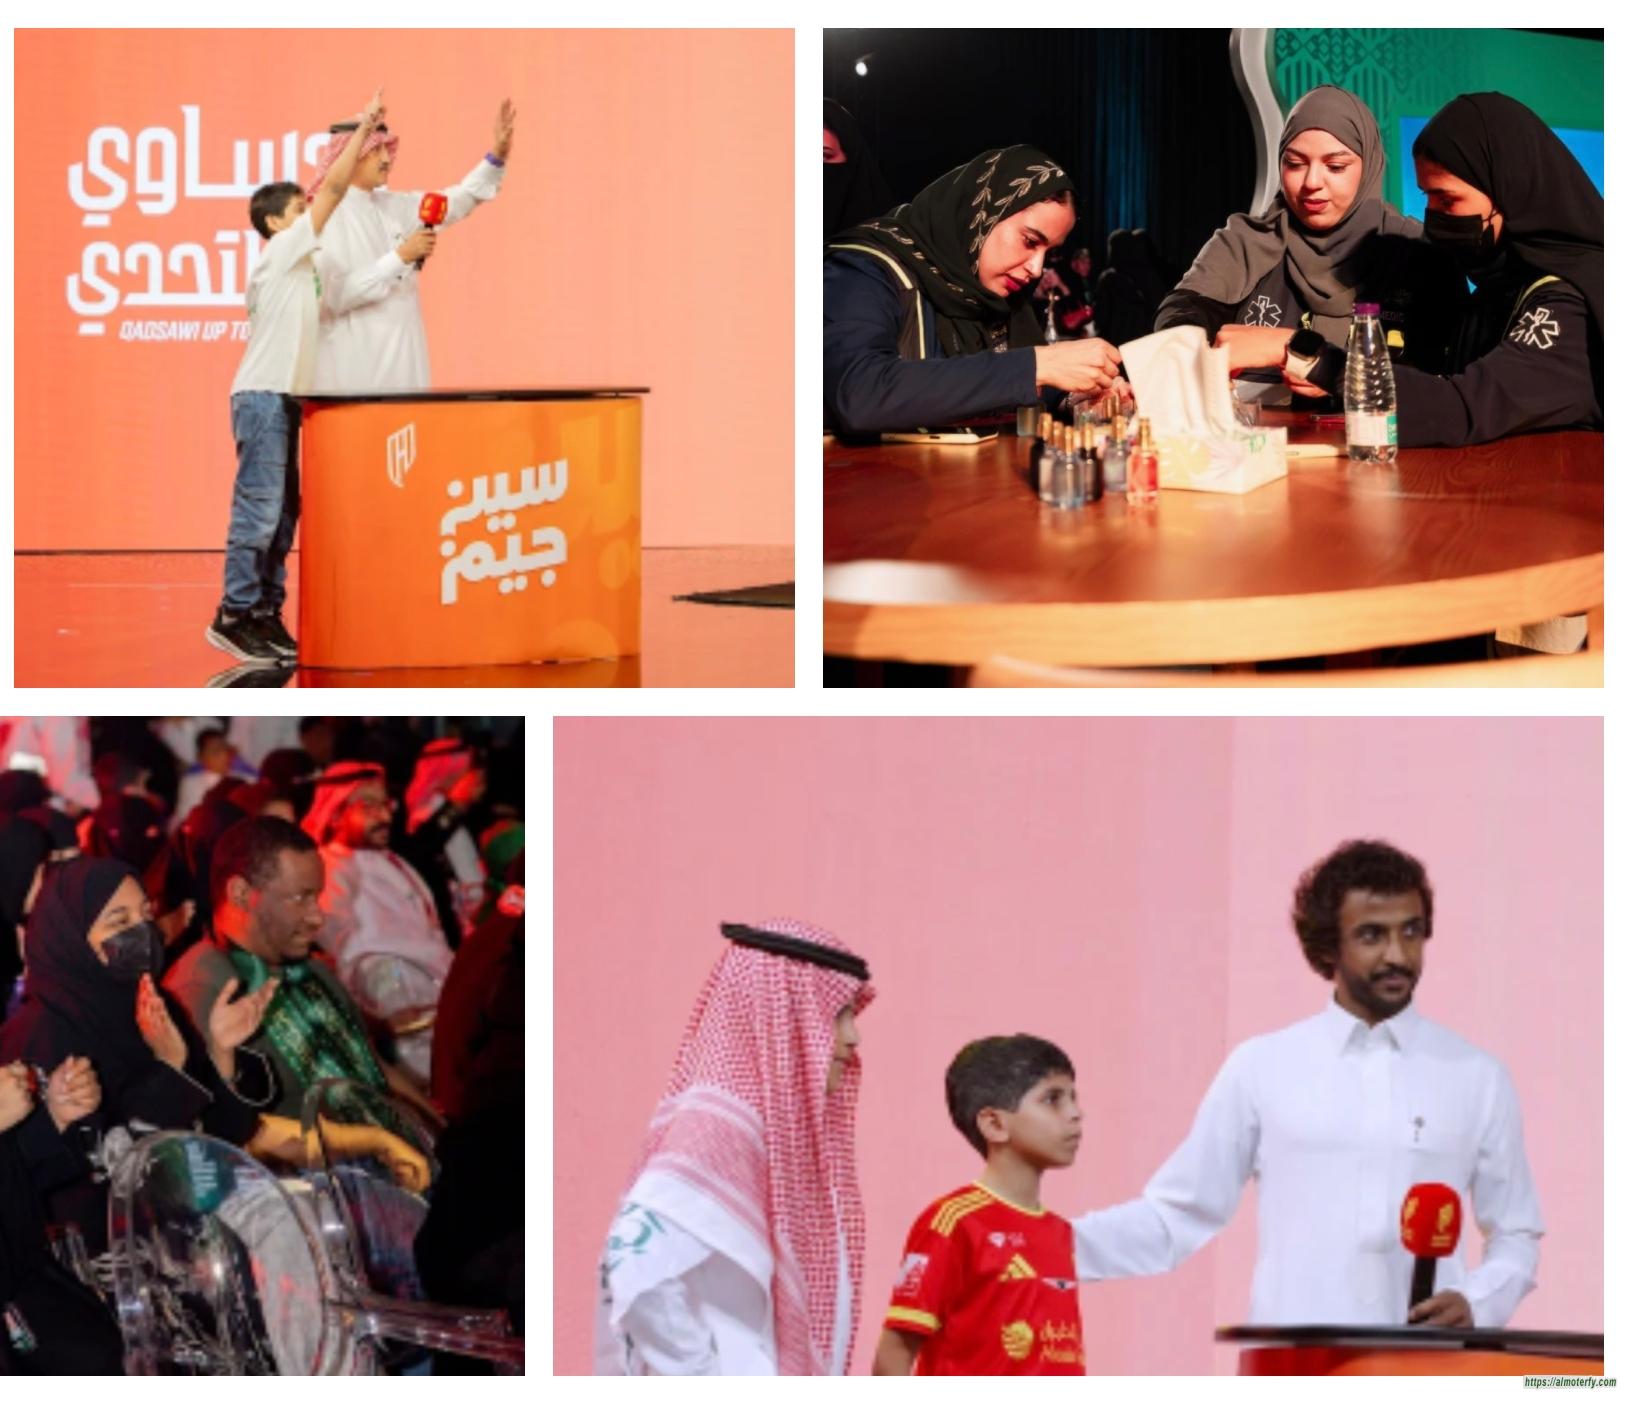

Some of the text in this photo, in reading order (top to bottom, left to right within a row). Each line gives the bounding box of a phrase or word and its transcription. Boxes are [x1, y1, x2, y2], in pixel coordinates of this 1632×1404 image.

[67, 104, 334, 228] ساوي
[65, 229, 262, 337] لتحدي
[202, 320, 228, 340] UP
